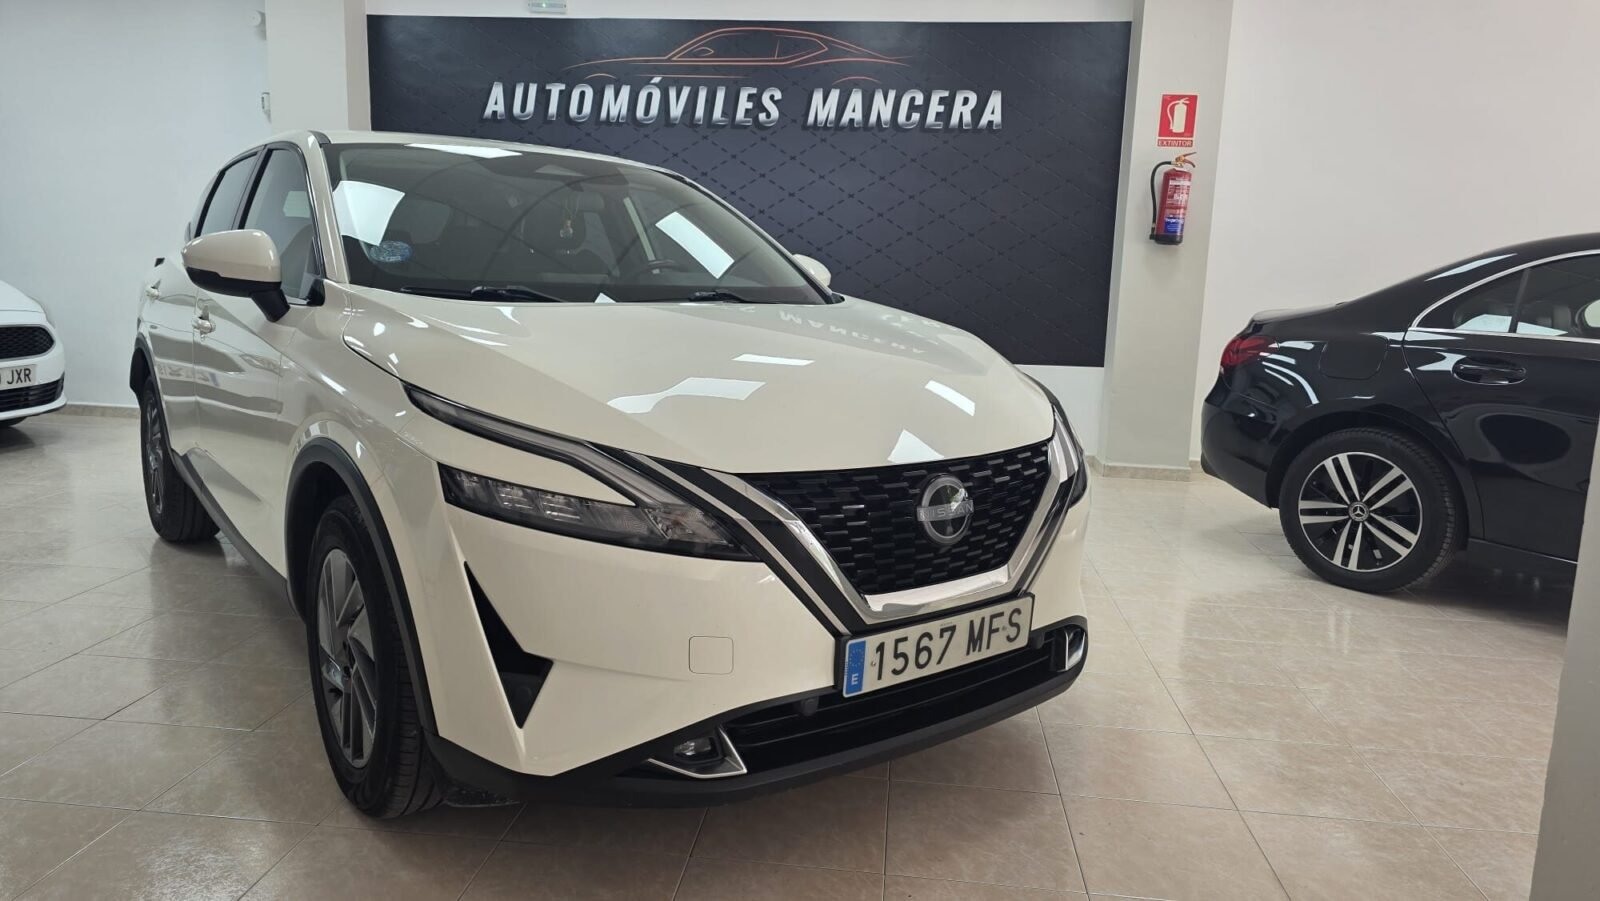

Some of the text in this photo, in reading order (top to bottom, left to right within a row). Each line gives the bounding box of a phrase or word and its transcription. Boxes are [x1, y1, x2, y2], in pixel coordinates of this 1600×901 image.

[482, 76, 1003, 130] AUTOMÓVILES MANCERA
[6, 367, 32, 385] JXR
[875, 607, 1022, 681] 1567 MFS
[851, 672, 859, 685] E
